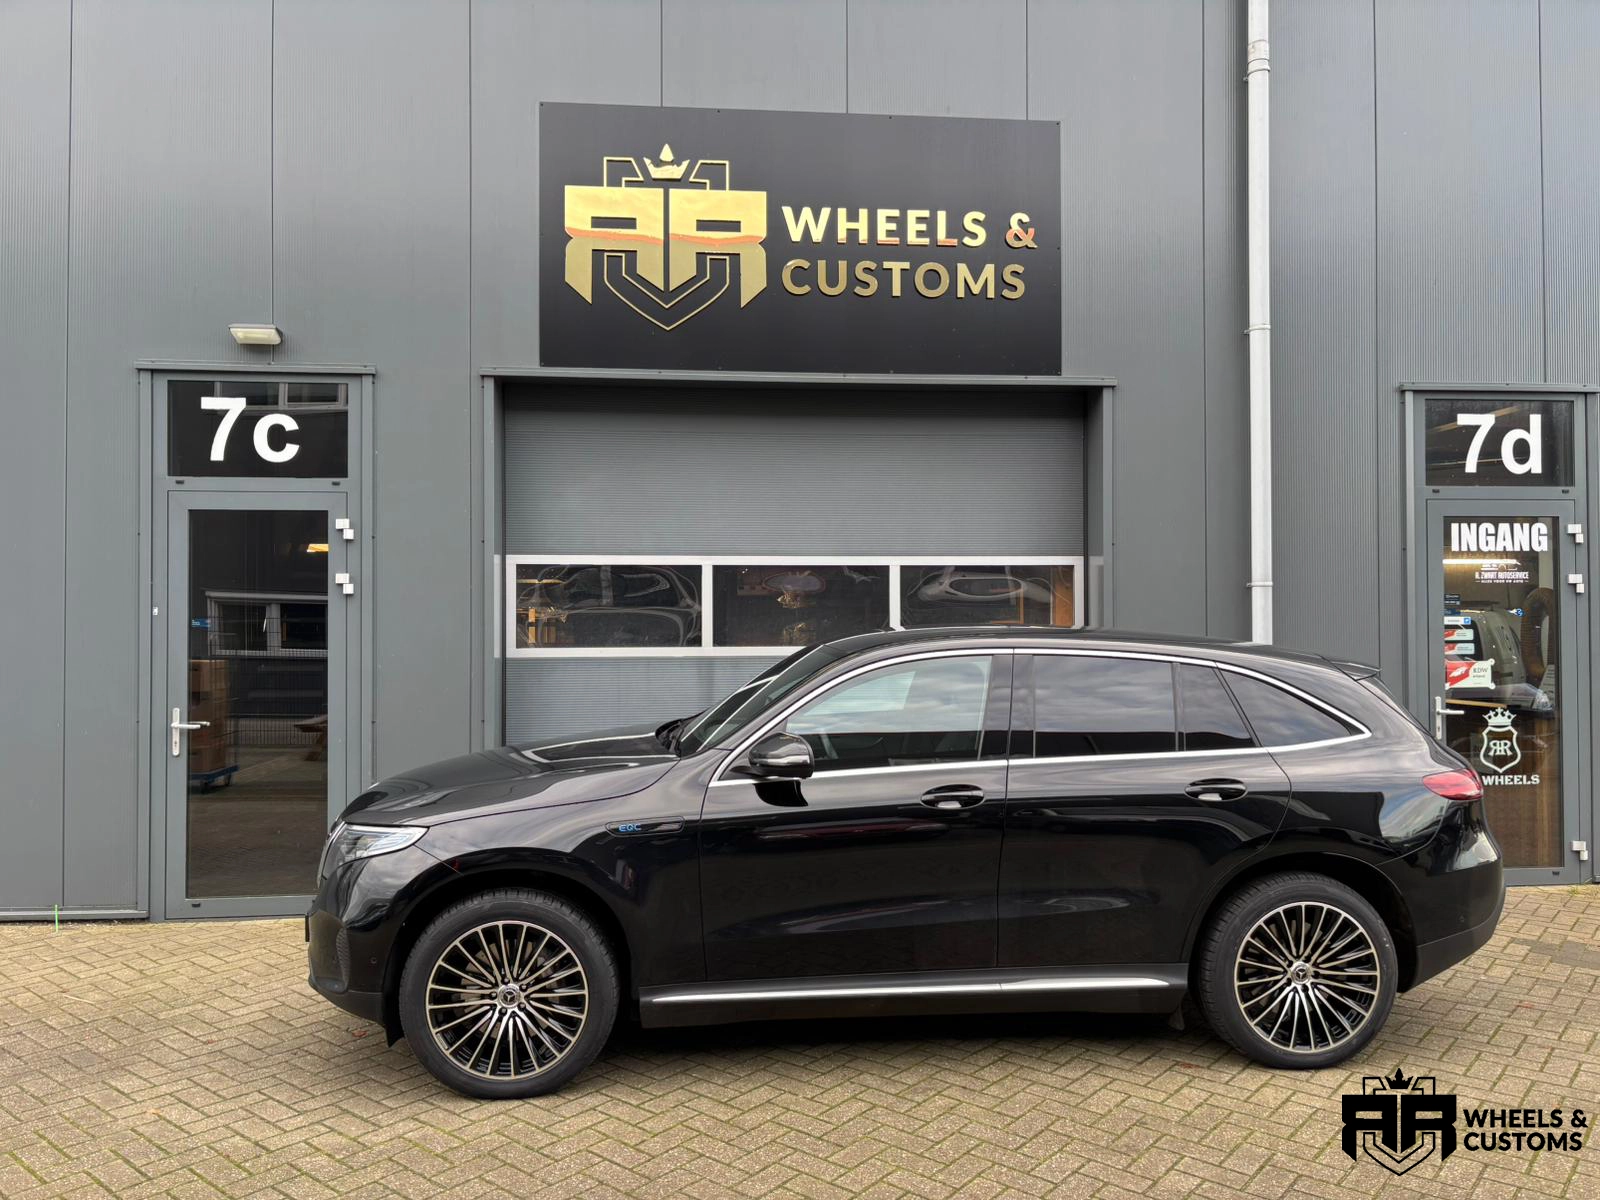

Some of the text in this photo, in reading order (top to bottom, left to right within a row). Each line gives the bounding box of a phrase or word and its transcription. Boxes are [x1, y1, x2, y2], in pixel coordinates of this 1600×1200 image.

[781, 205, 1038, 249] WHEELS &
[781, 259, 1026, 300] CUSTOMS
[200, 396, 300, 463] 7c
[1456, 413, 1543, 475] 7d
[1450, 522, 1549, 552] INGANG
[1497, 571, 1529, 579] AUTOSERVICE
[1481, 774, 1540, 786] WHEELS
[618, 823, 642, 832] EQC
